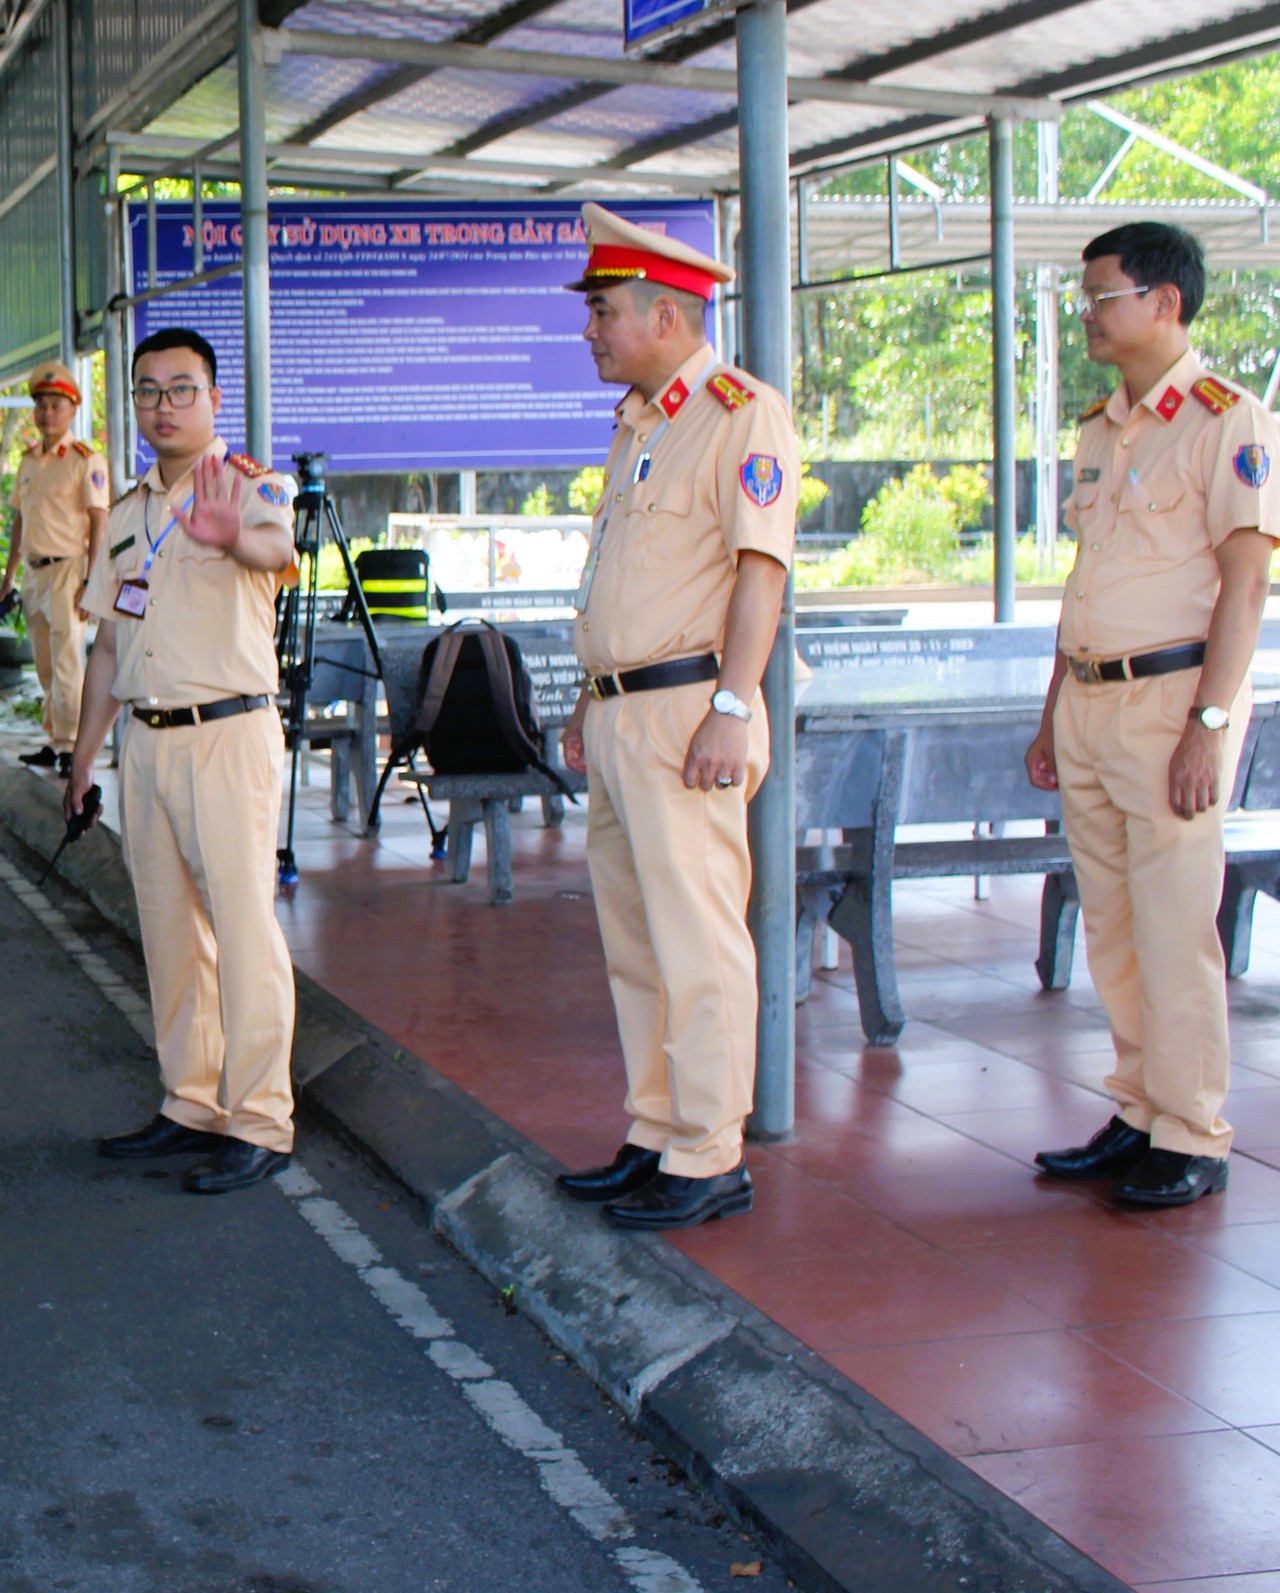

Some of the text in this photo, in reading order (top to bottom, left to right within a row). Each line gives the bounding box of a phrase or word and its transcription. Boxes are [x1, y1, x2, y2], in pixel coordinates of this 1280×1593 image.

[320, 223, 387, 249] DỤNG
[389, 223, 421, 246] XE
[425, 222, 505, 245] TRONG
[509, 217, 554, 244] SÂN
[557, 217, 588, 244] SÁ
